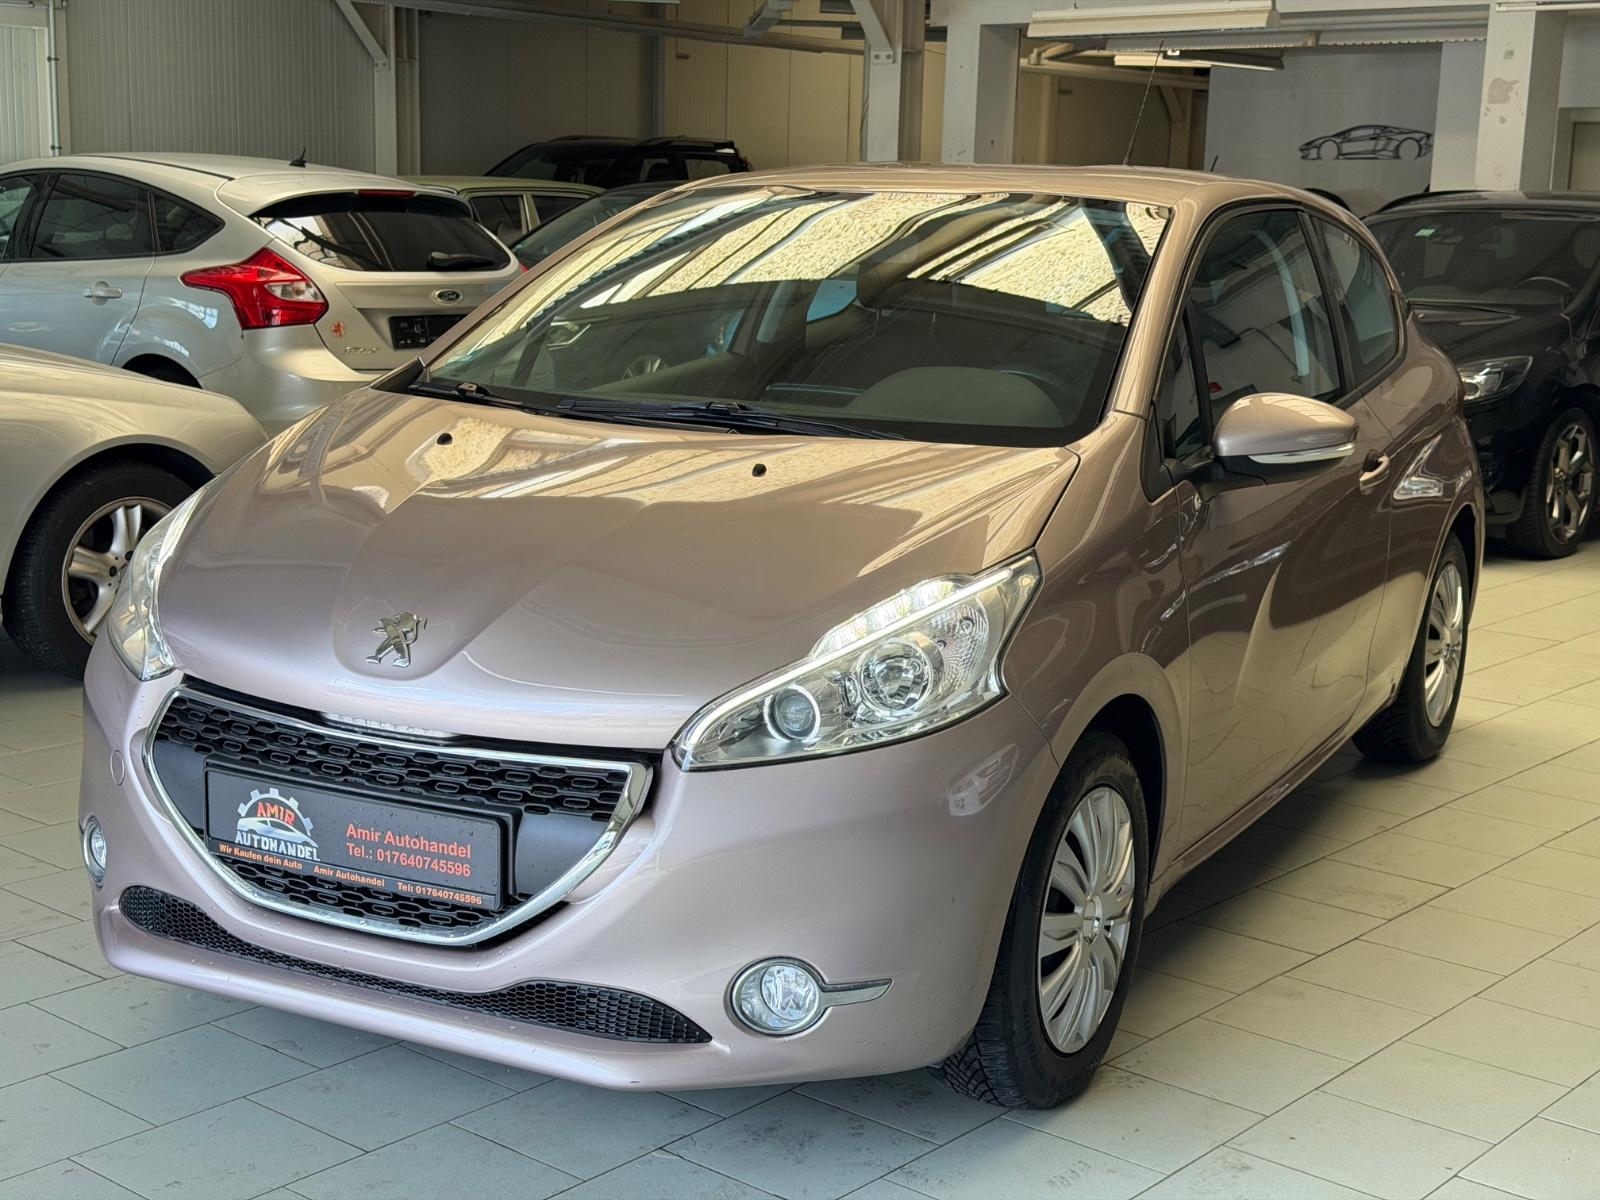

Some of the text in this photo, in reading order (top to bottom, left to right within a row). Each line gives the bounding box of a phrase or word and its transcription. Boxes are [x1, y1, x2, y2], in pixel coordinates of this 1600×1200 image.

[256, 801, 295, 825] AMIR
[234, 831, 320, 861] AUTOHANDEL
[346, 823, 471, 858] Amir Autohandel
[219, 843, 303, 870] Wir Kaufen dein Auto
[346, 843, 471, 877] Tel.: 017640745596
[313, 865, 385, 887] Amir Autohandel
[397, 882, 482, 905] Tel: 017640745596
